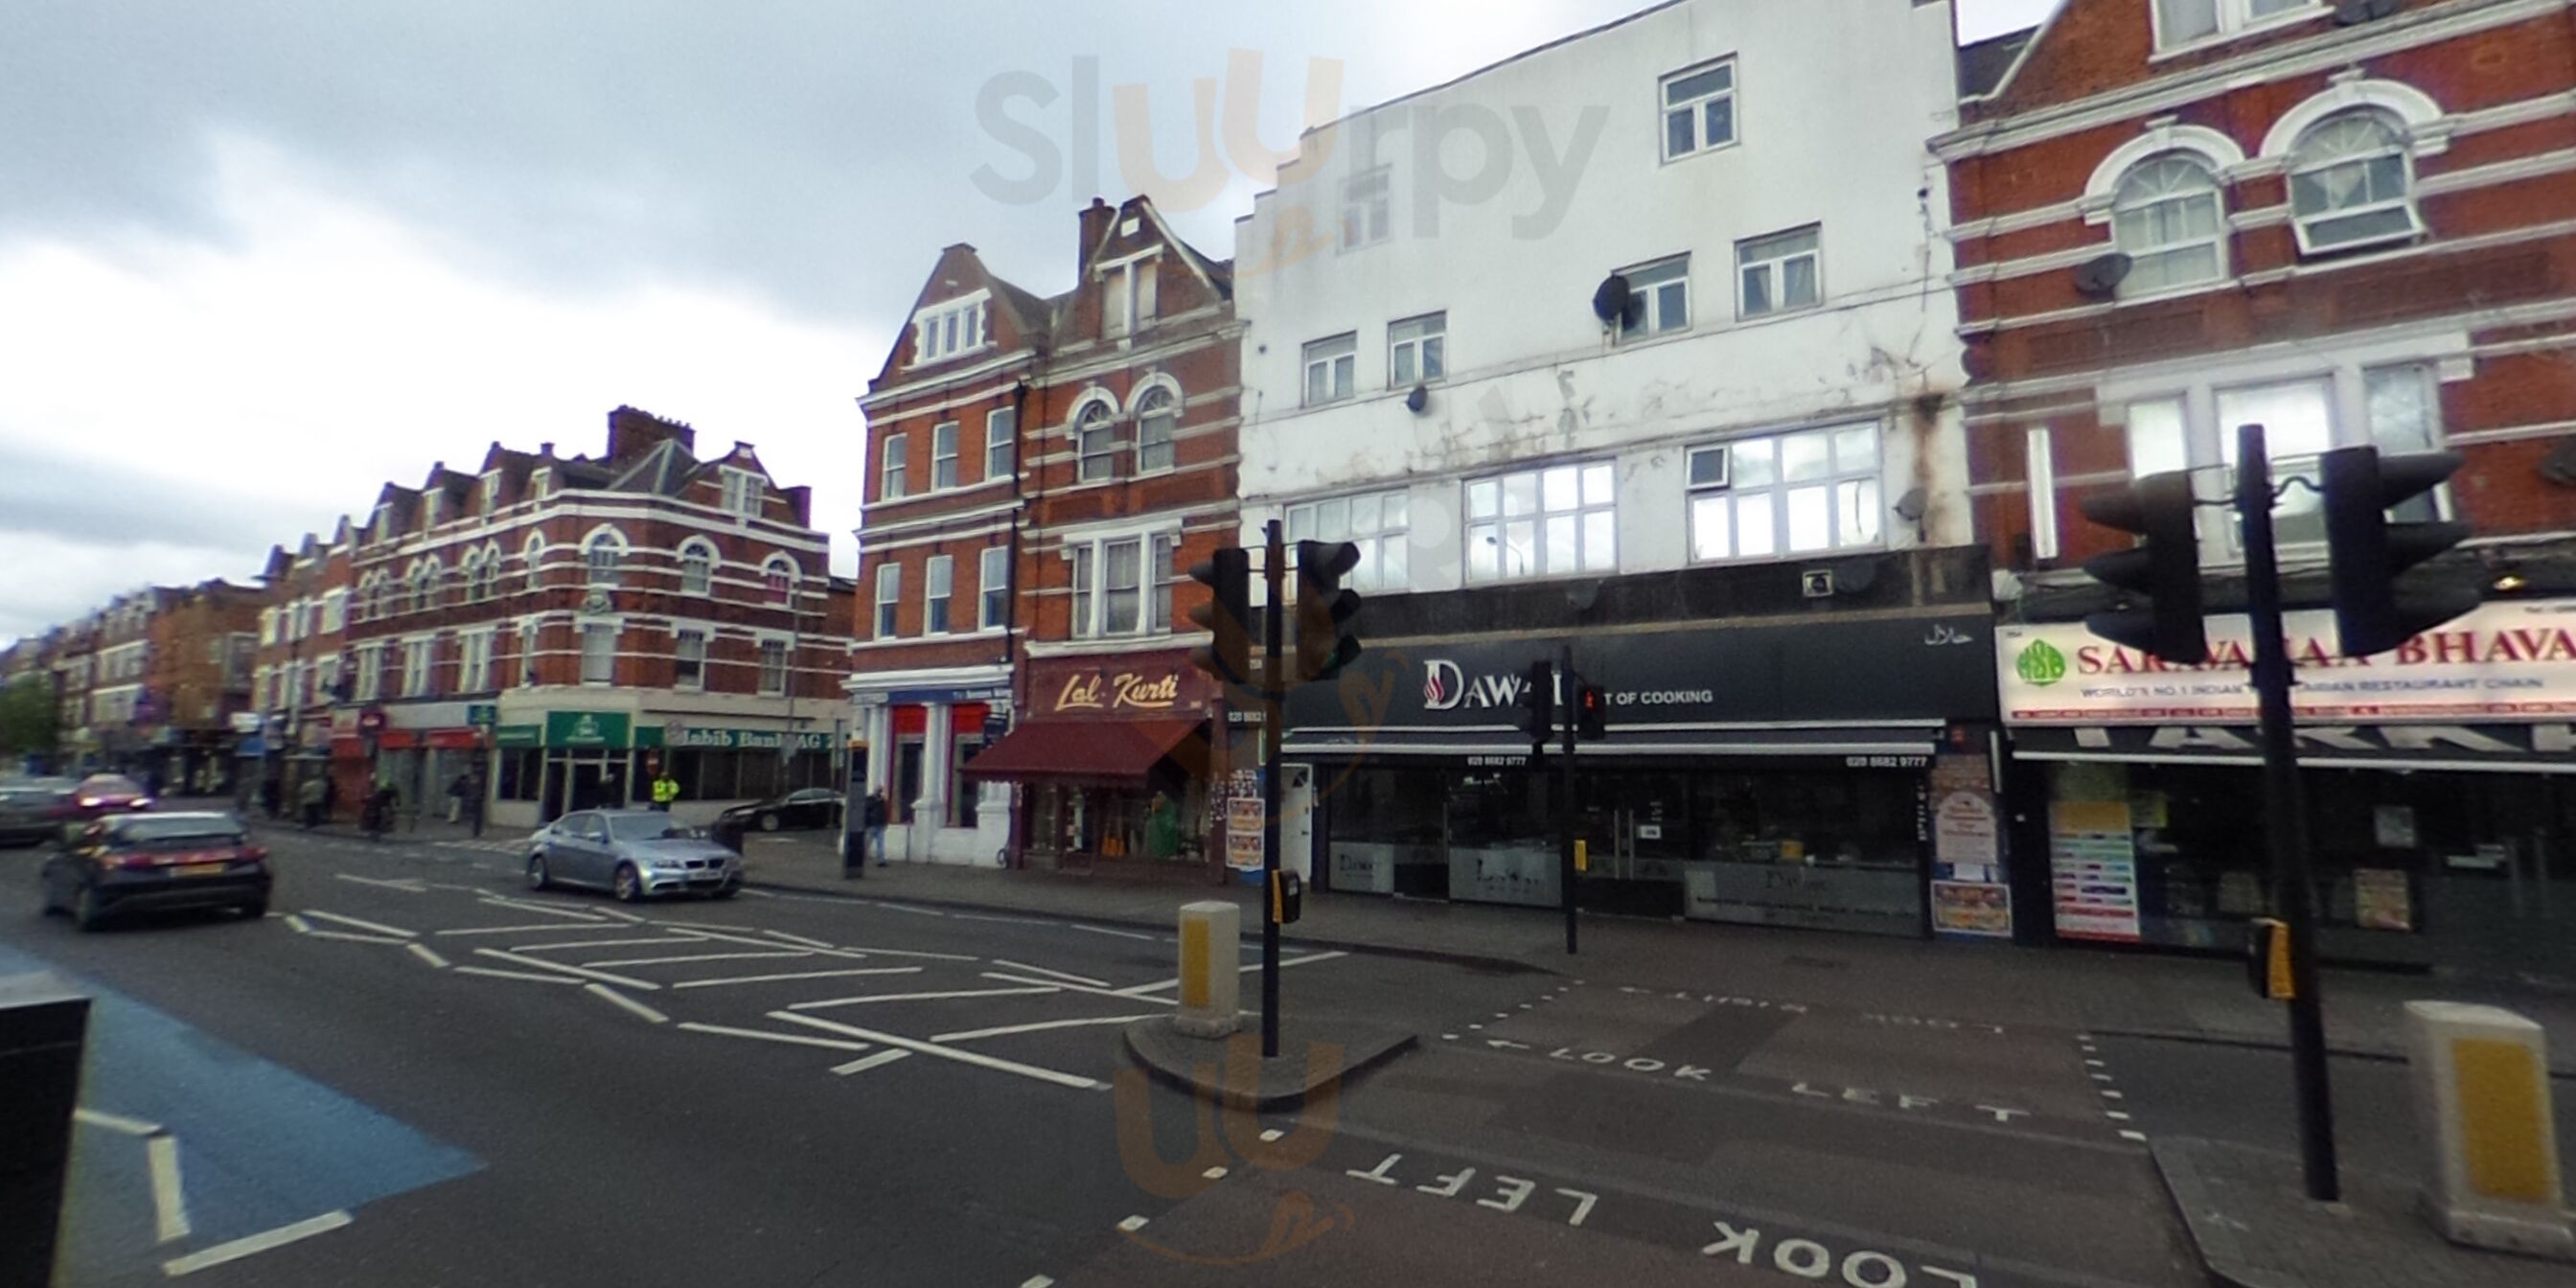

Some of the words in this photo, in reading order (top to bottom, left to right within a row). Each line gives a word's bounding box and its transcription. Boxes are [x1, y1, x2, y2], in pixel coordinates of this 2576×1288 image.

[1054, 674, 1104, 711] Lal
[1113, 673, 1180, 709] Kurti
[1617, 692, 1638, 705] OF
[1641, 689, 1714, 705] COOKING
[2358, 678, 2479, 692] RESTAURANT
[2484, 678, 2544, 690] CHAIN
[1549, 1046, 1713, 1082] LOOK
[1791, 1082, 2032, 1123] LEFT
[1346, 1153, 1599, 1227] LEFT
